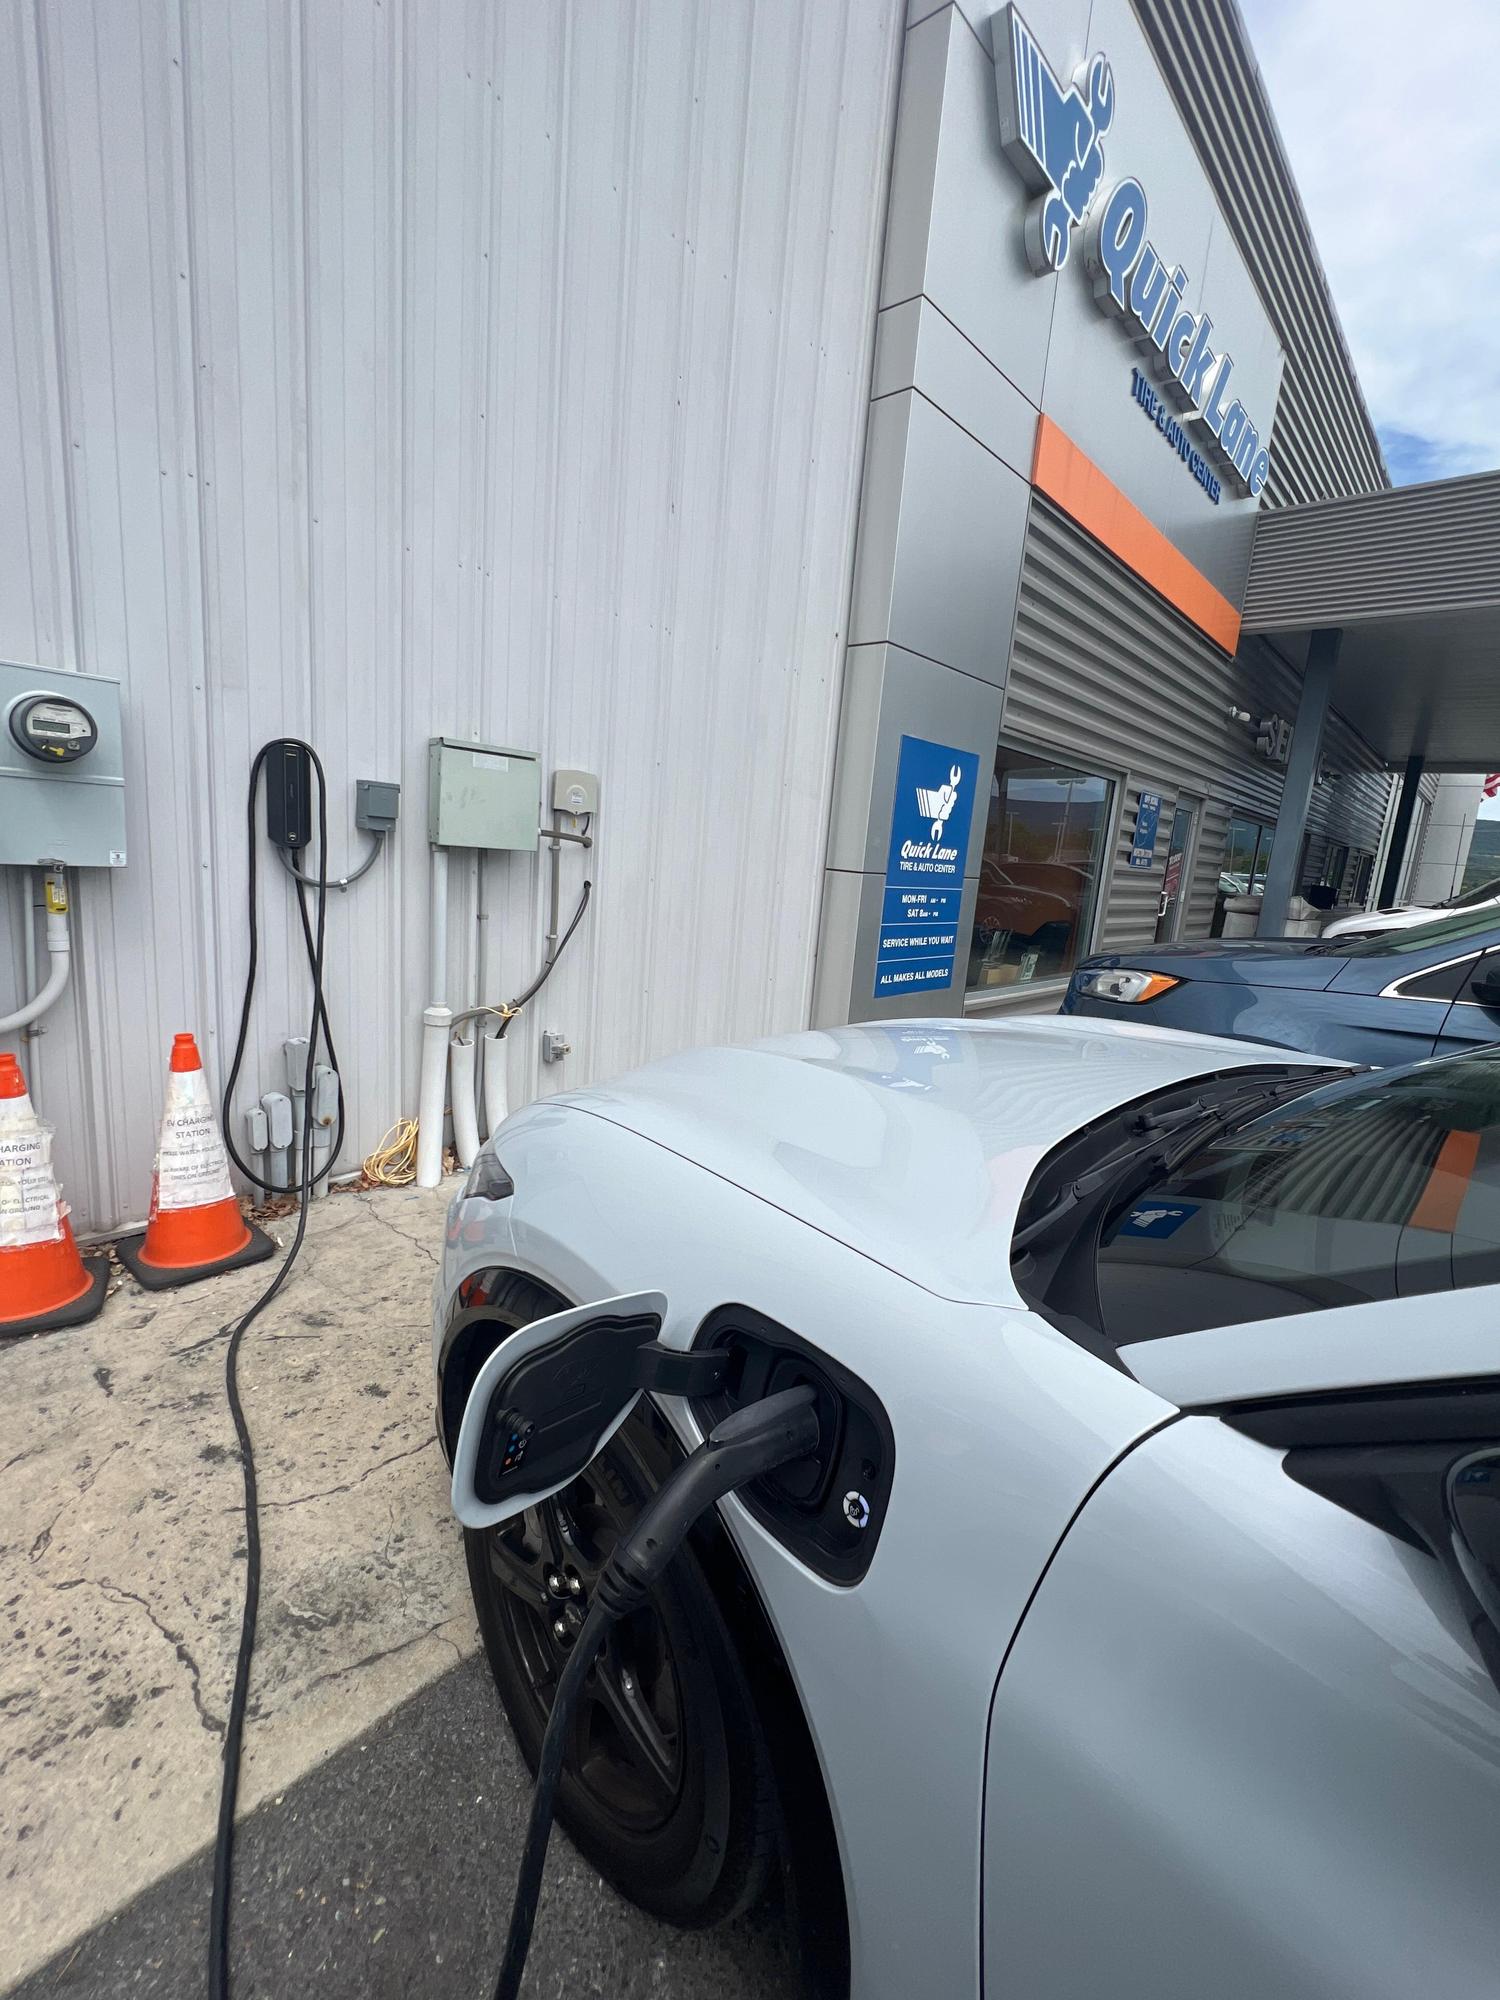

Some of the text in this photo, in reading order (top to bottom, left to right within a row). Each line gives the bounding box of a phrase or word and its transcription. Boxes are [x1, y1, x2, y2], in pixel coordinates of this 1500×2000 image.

[1098, 176, 1271, 497] Quick Lane
[1131, 367, 1221, 505] TIRE & AUTO CENTER
[901, 840, 958, 860] Quick Lane
[900, 861, 956, 873] TIRE & AUTO CENTER
[901, 894, 927, 903] MON-FRI
[907, 909, 919, 918] SAT
[882, 935, 954, 948] SERVICE WHILE YOU WAIT
[880, 968, 949, 984] ALL MAKES ALL MODELS
[175, 1128, 210, 1139] STATION
